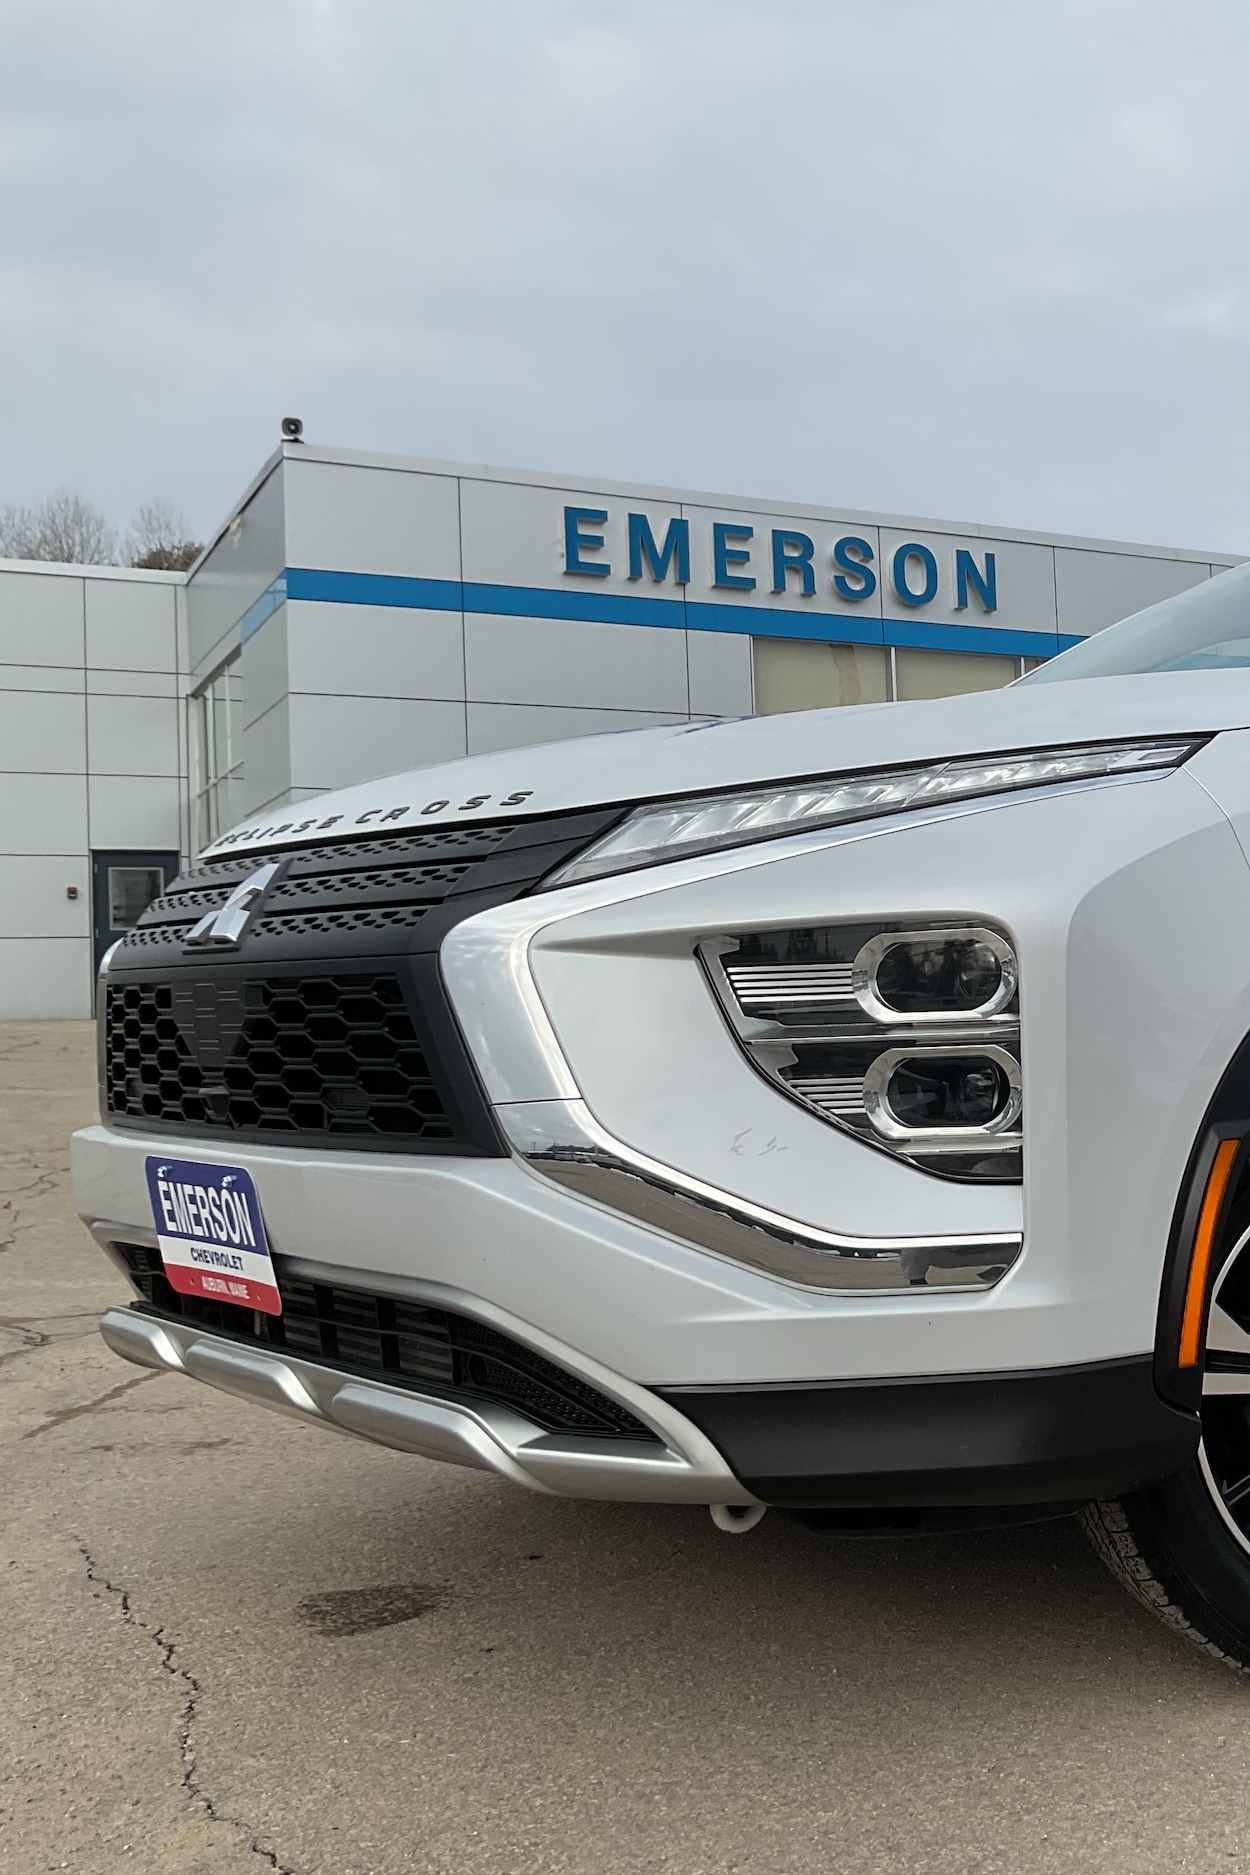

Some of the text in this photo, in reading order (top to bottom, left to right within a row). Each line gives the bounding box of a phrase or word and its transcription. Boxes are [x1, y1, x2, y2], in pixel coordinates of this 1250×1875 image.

[565, 506, 997, 612] EMERSON
[215, 791, 534, 847] ECLIPSE CROSS
[158, 1180, 256, 1247] EMERSON
[190, 1247, 244, 1271] CHEVROLET
